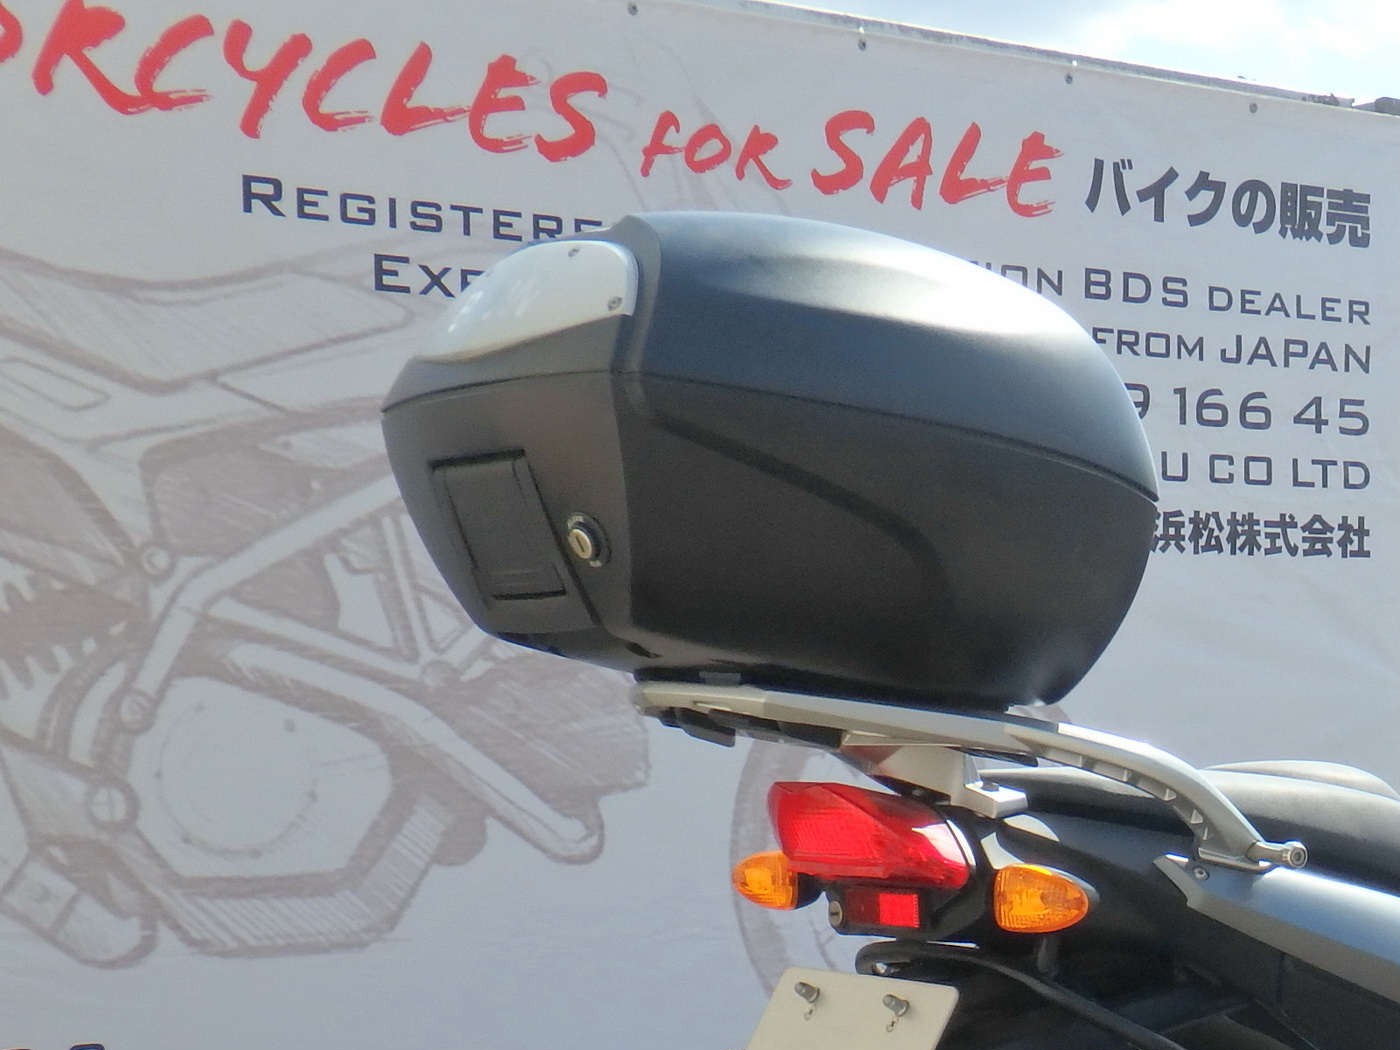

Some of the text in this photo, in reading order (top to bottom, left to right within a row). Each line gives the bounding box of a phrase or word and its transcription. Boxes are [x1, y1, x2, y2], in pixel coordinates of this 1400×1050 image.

[811, 110, 1064, 218] SALE
[1085, 157, 1371, 248] バイクの販売
[1084, 267, 1189, 308] BDS
[1208, 286, 1371, 325] DEALER
[1092, 327, 1204, 361] FROM
[1220, 335, 1371, 374] JAPAN
[1173, 387, 1272, 430] 166
[1293, 396, 1370, 436] 45
[1209, 454, 1273, 486] CO
[1292, 458, 1371, 490] LTD
